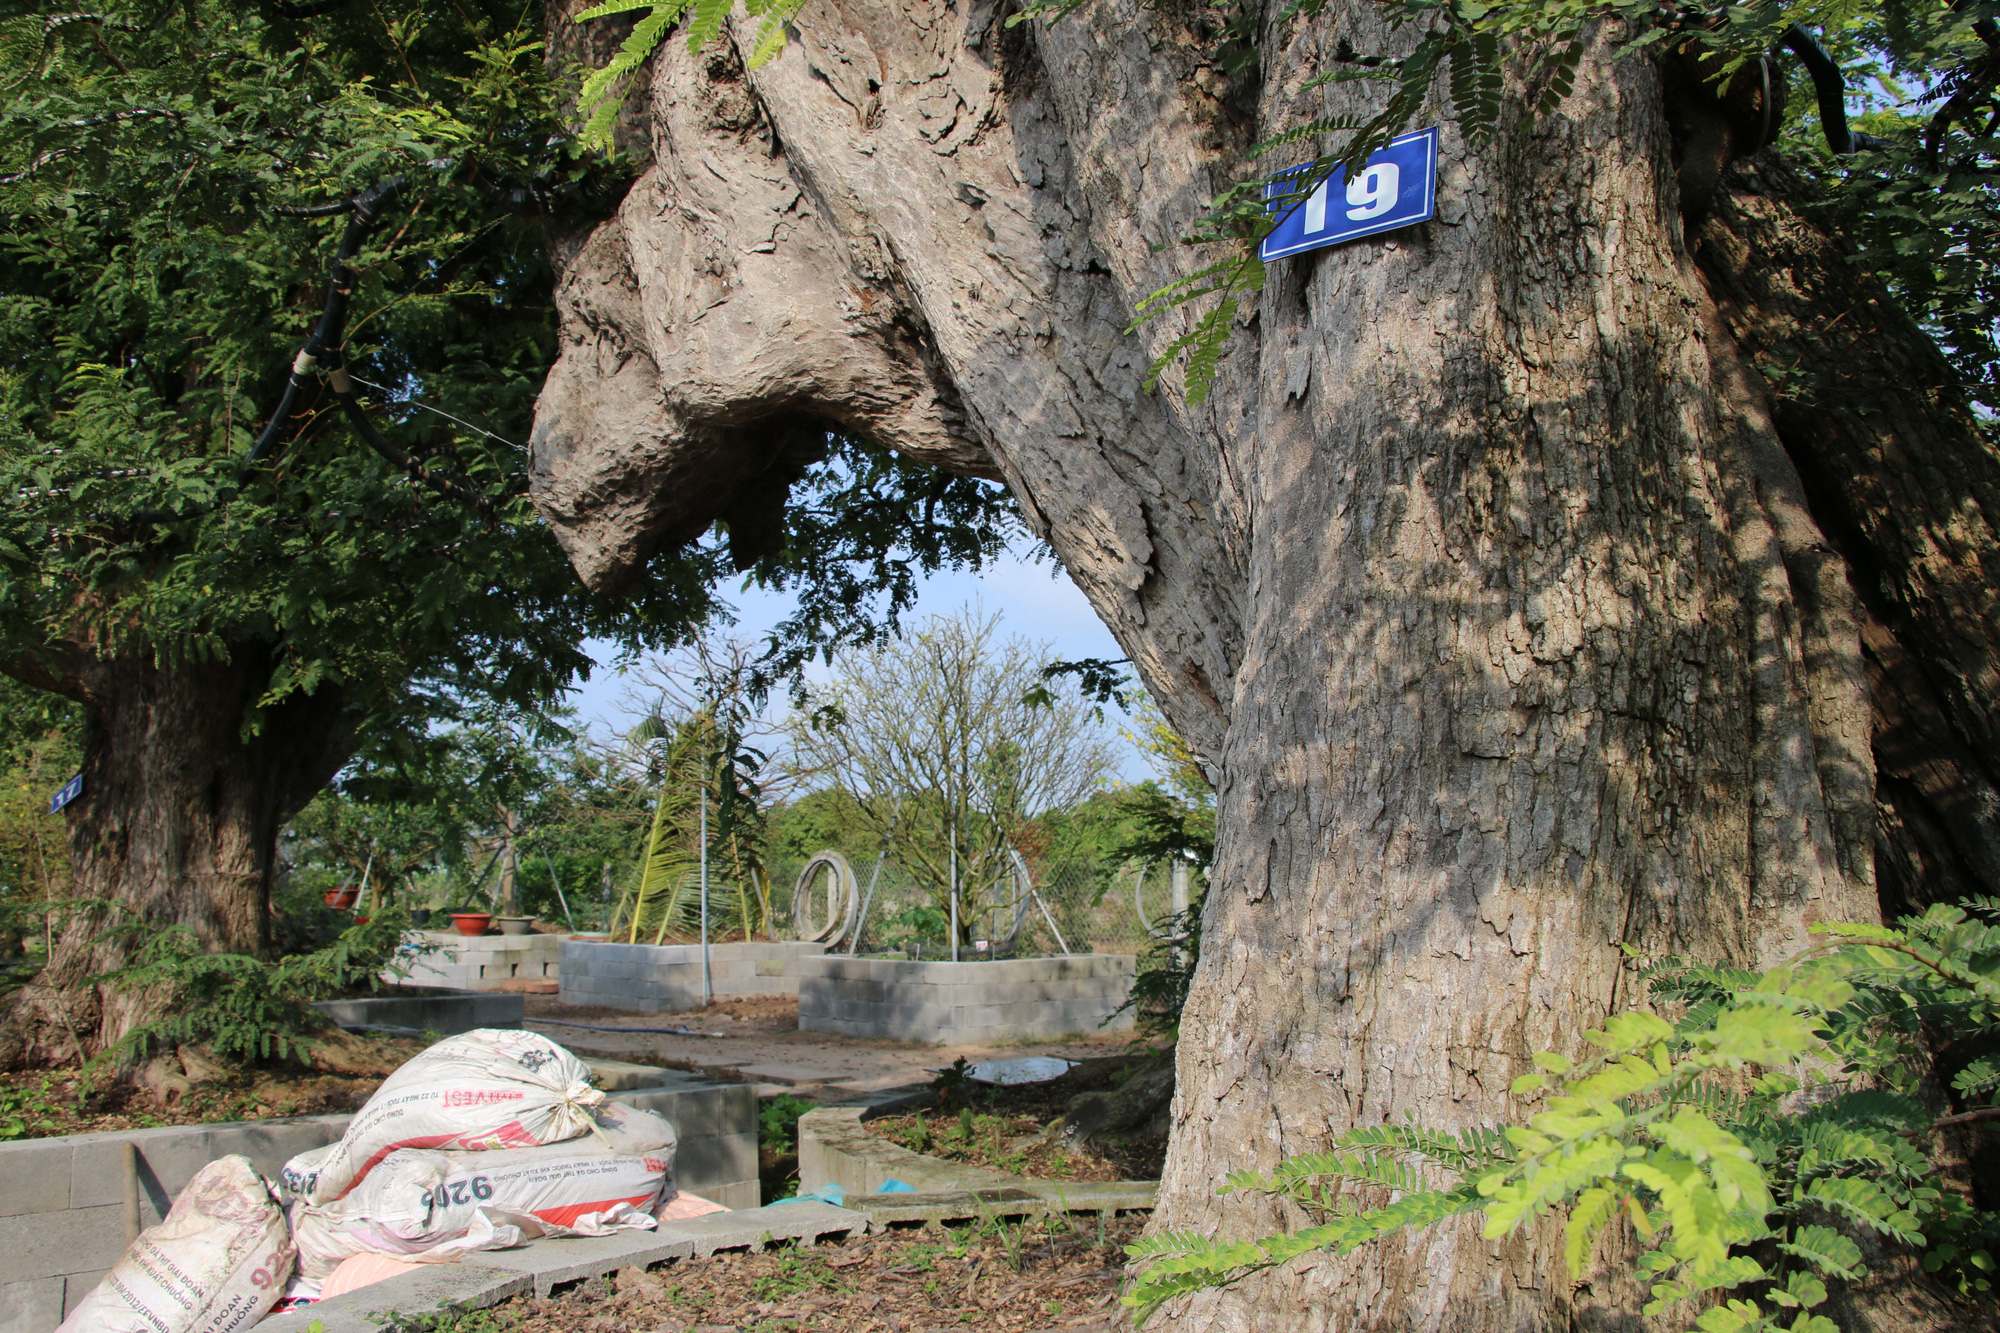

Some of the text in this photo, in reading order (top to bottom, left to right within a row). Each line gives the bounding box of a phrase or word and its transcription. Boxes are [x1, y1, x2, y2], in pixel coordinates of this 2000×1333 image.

[1296, 162, 1400, 235] 19
[55, 782, 77, 805] 17
[167, 1263, 183, 1279] GIAI
[180, 1275, 205, 1299] ĐOẠN
[213, 1294, 242, 1325] ĐOẠN
